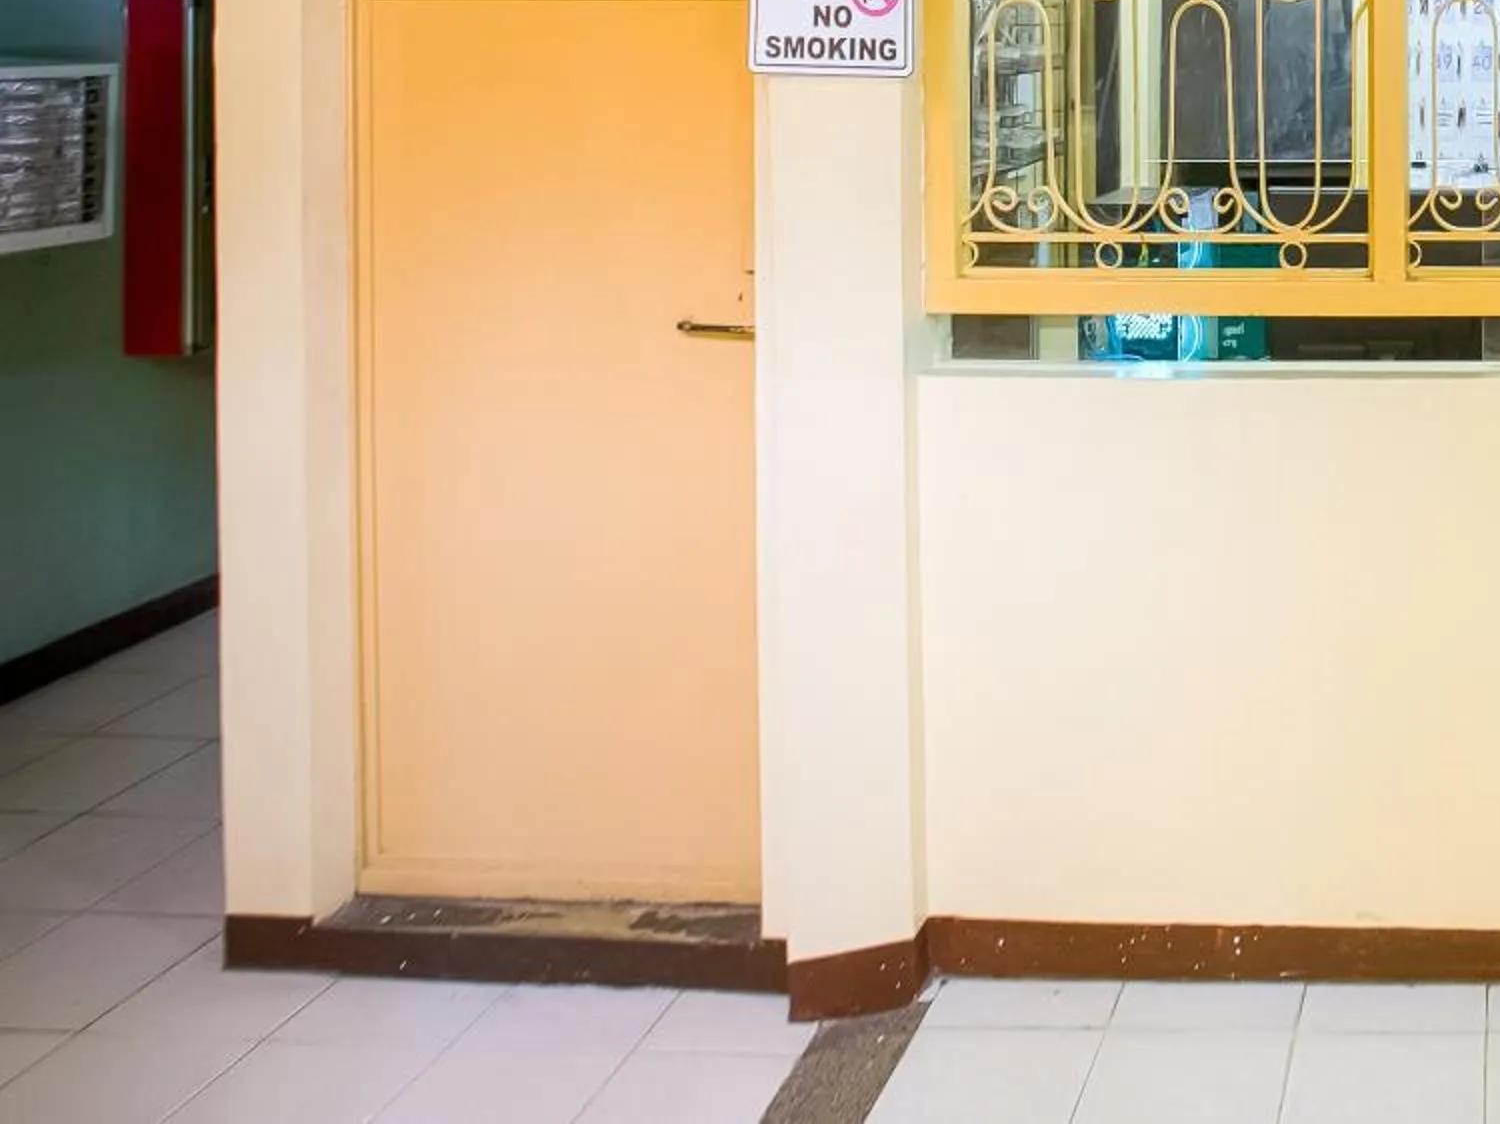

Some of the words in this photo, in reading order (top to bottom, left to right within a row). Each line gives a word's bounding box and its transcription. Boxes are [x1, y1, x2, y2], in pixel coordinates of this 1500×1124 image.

[813, 5, 853, 29] NO
[765, 36, 898, 61] SMOKING
[1471, 54, 1492, 72] 40
